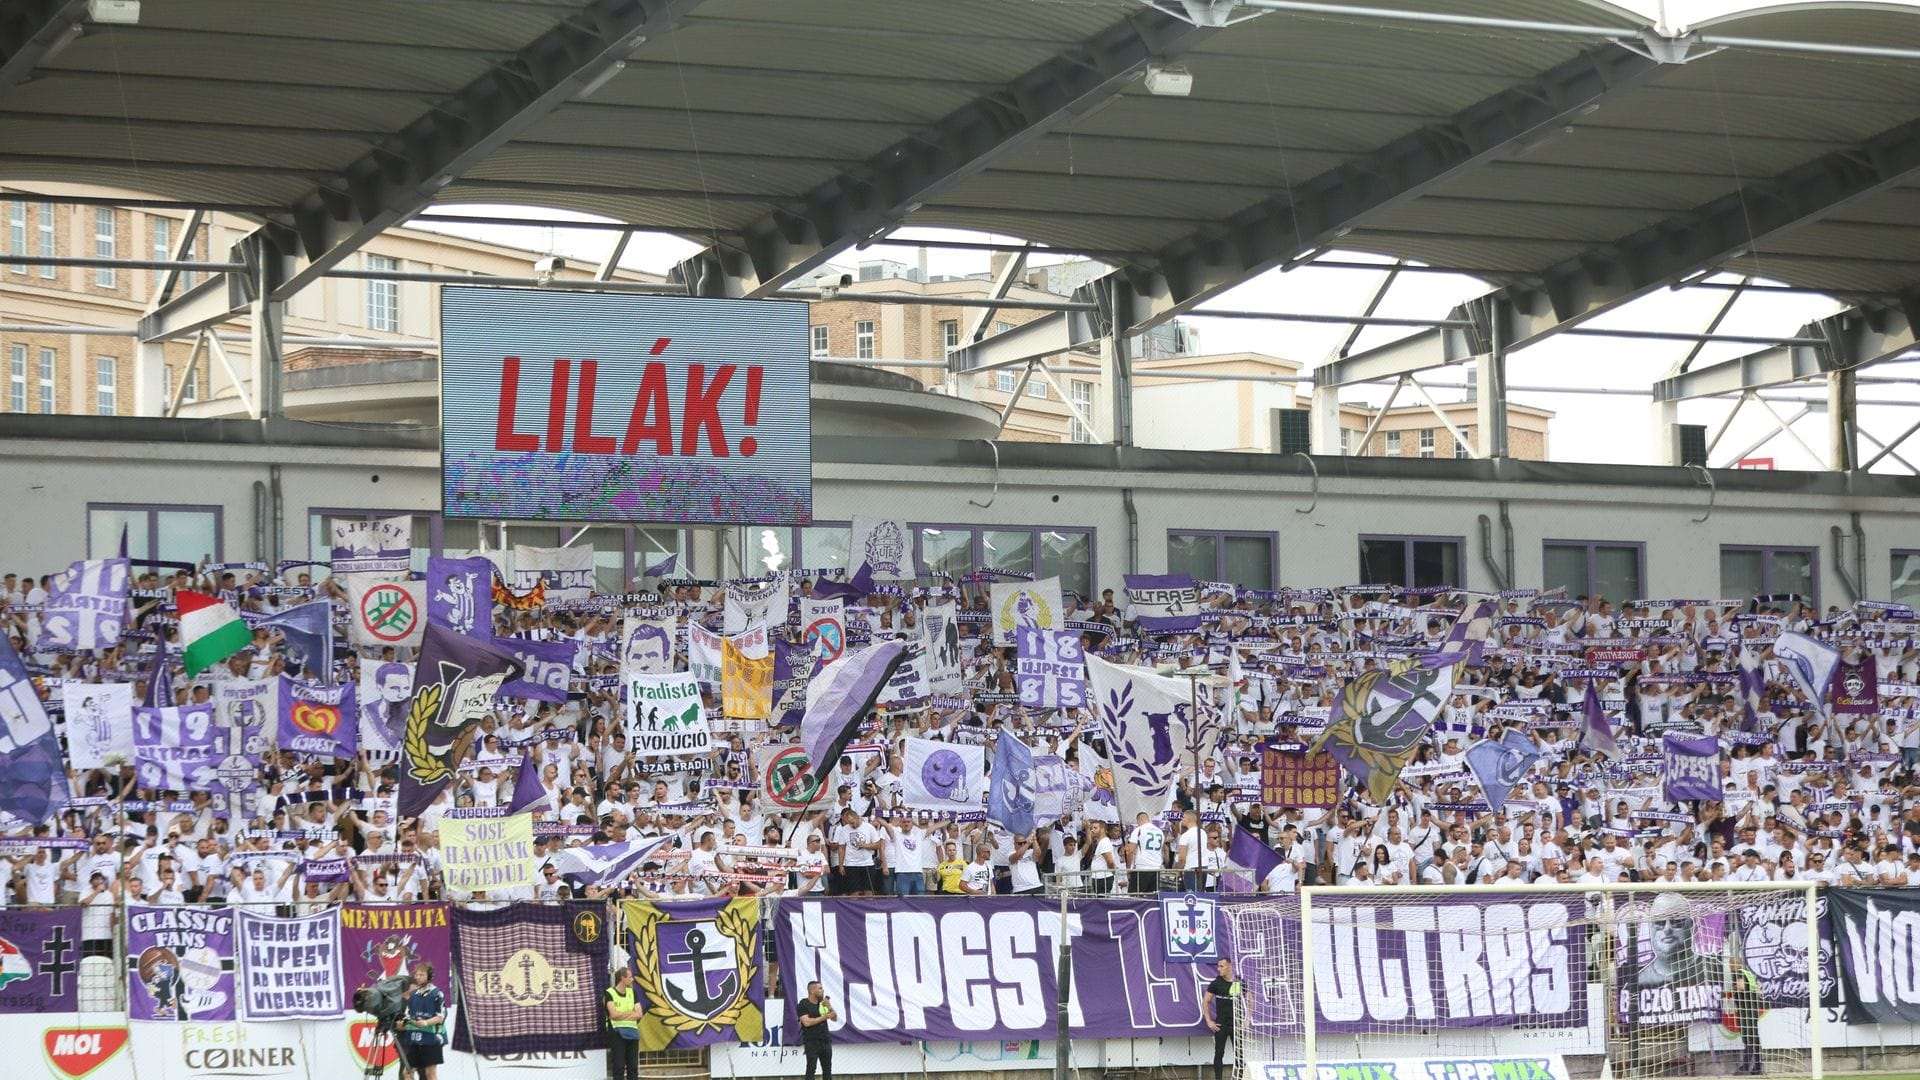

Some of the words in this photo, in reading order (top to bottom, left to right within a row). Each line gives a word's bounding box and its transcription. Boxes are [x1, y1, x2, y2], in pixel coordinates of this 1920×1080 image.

[495, 337, 763, 458] LILÁK!
[626, 594, 658, 602] FRADI
[1129, 588, 1197, 602] ULTRAS
[811, 604, 840, 615] STOP
[632, 680, 699, 700] fradista
[632, 729, 708, 752] EVOLÚCIÓ
[642, 763, 671, 774] SZAR
[1263, 787, 1296, 804] UTE
[464, 821, 507, 842] SOSE
[1146, 832, 1163, 851] 23
[446, 841, 529, 864] HAGYUNK
[131, 909, 233, 935] CLASSIC
[155, 931, 207, 949] FANS
[790, 901, 1086, 1032] ÚJPEST
[1312, 902, 1571, 1023] ULTRAS
[52, 1032, 103, 1057] MOL
[1523, 1031, 1575, 1040] NATURA
[185, 1047, 296, 1070] CORNER
